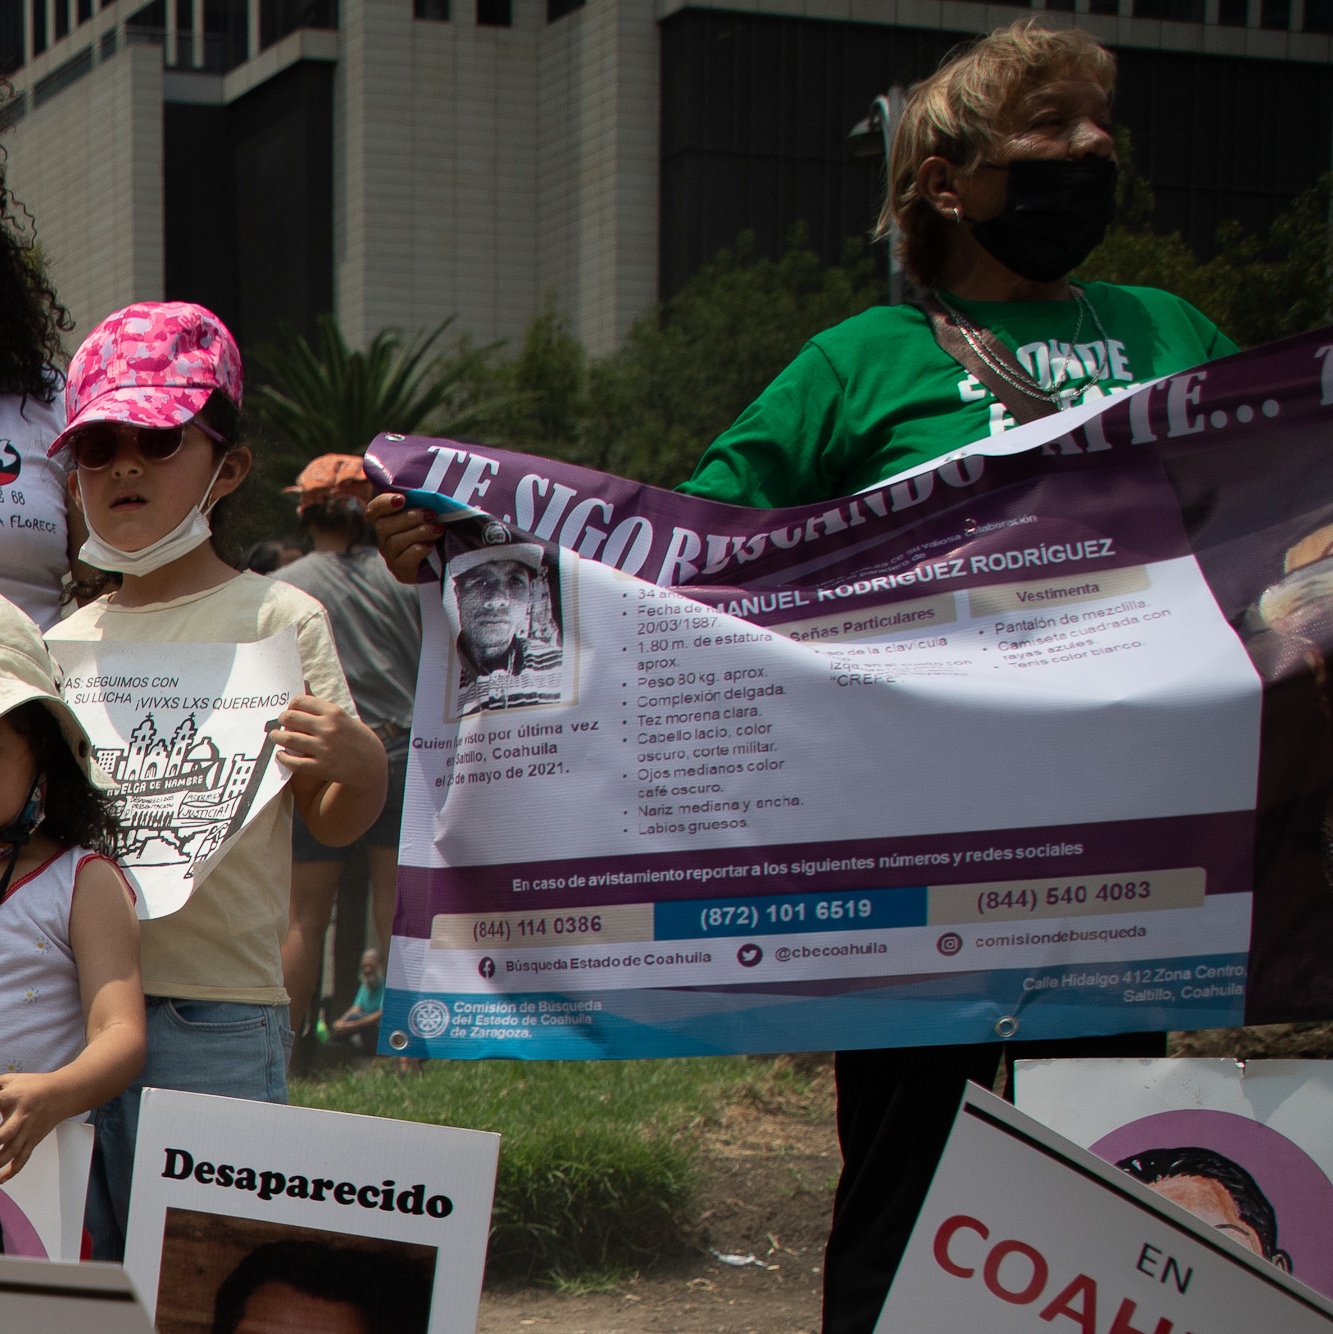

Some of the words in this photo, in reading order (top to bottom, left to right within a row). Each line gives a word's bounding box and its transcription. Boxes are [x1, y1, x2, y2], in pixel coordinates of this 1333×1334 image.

[11, 490, 25, 505] 68
[10, 515, 57, 534] FLORECE
[970, 537, 1116, 576] RODRÍGUEZ
[1016, 581, 1100, 603] Vestimenta
[789, 626, 839, 644] Señas
[843, 606, 936, 635] Particulares
[412, 737, 452, 750] Quien
[488, 729, 512, 744] por
[517, 724, 563, 739] última
[570, 720, 600, 732] vez
[492, 742, 558, 760] Coahuila
[468, 770, 501, 785] mayo
[506, 766, 523, 779] de
[528, 762, 570, 777] 2021.
[512, 878, 530, 893] En
[533, 877, 566, 891] caso
[568, 874, 586, 888] de
[588, 868, 684, 887] avistamiento
[686, 865, 750, 883] reportar
[764, 862, 788, 876] los
[791, 857, 875, 876] siguientes
[879, 853, 949, 868] números
[966, 847, 1013, 863] redes
[1015, 842, 1083, 859] sociales
[977, 889, 1037, 915] (844)
[1046, 886, 1087, 905] 540
[1095, 881, 1152, 902] 4083
[700, 905, 759, 931] (872)
[766, 903, 806, 923] 101
[815, 899, 873, 920] 6519
[473, 921, 510, 942] (844)
[518, 919, 546, 936] 114
[554, 916, 602, 933] 0386
[975, 925, 1147, 948] comisiondebusqueda
[506, 959, 568, 973] Búsqueda
[570, 957, 621, 969] Estado
[622, 956, 641, 966] de
[643, 952, 712, 966] Coahuila
[775, 942, 888, 962] @cbecoahuila
[161, 1146, 454, 1220] Desaparecido
[1135, 1241, 1194, 1295] EN
